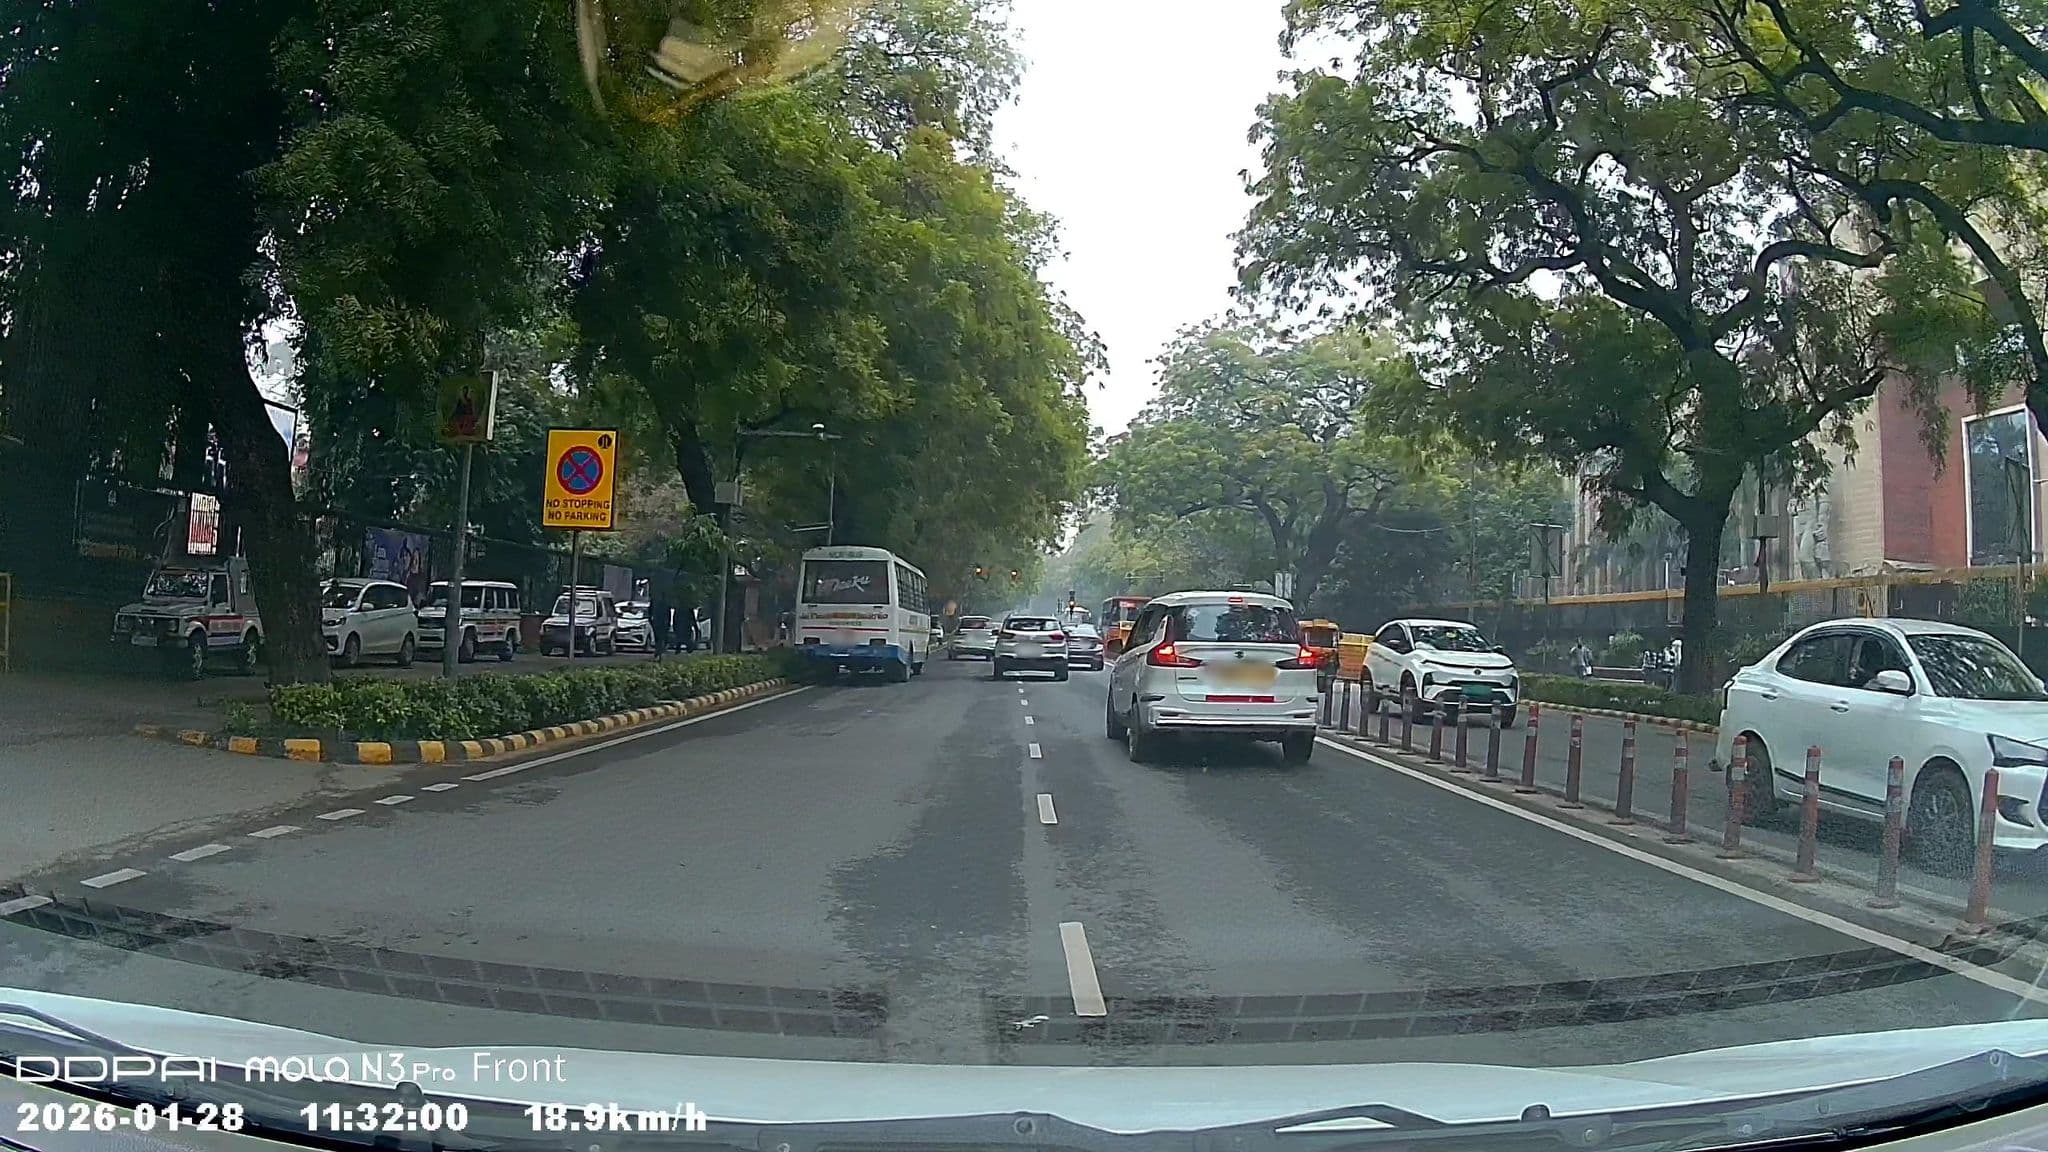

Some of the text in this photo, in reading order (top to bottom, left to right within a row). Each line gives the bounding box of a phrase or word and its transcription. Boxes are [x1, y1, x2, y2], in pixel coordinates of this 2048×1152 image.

[546, 499, 610, 509] NO STOPPING
[548, 511, 607, 521] NO PARKING
